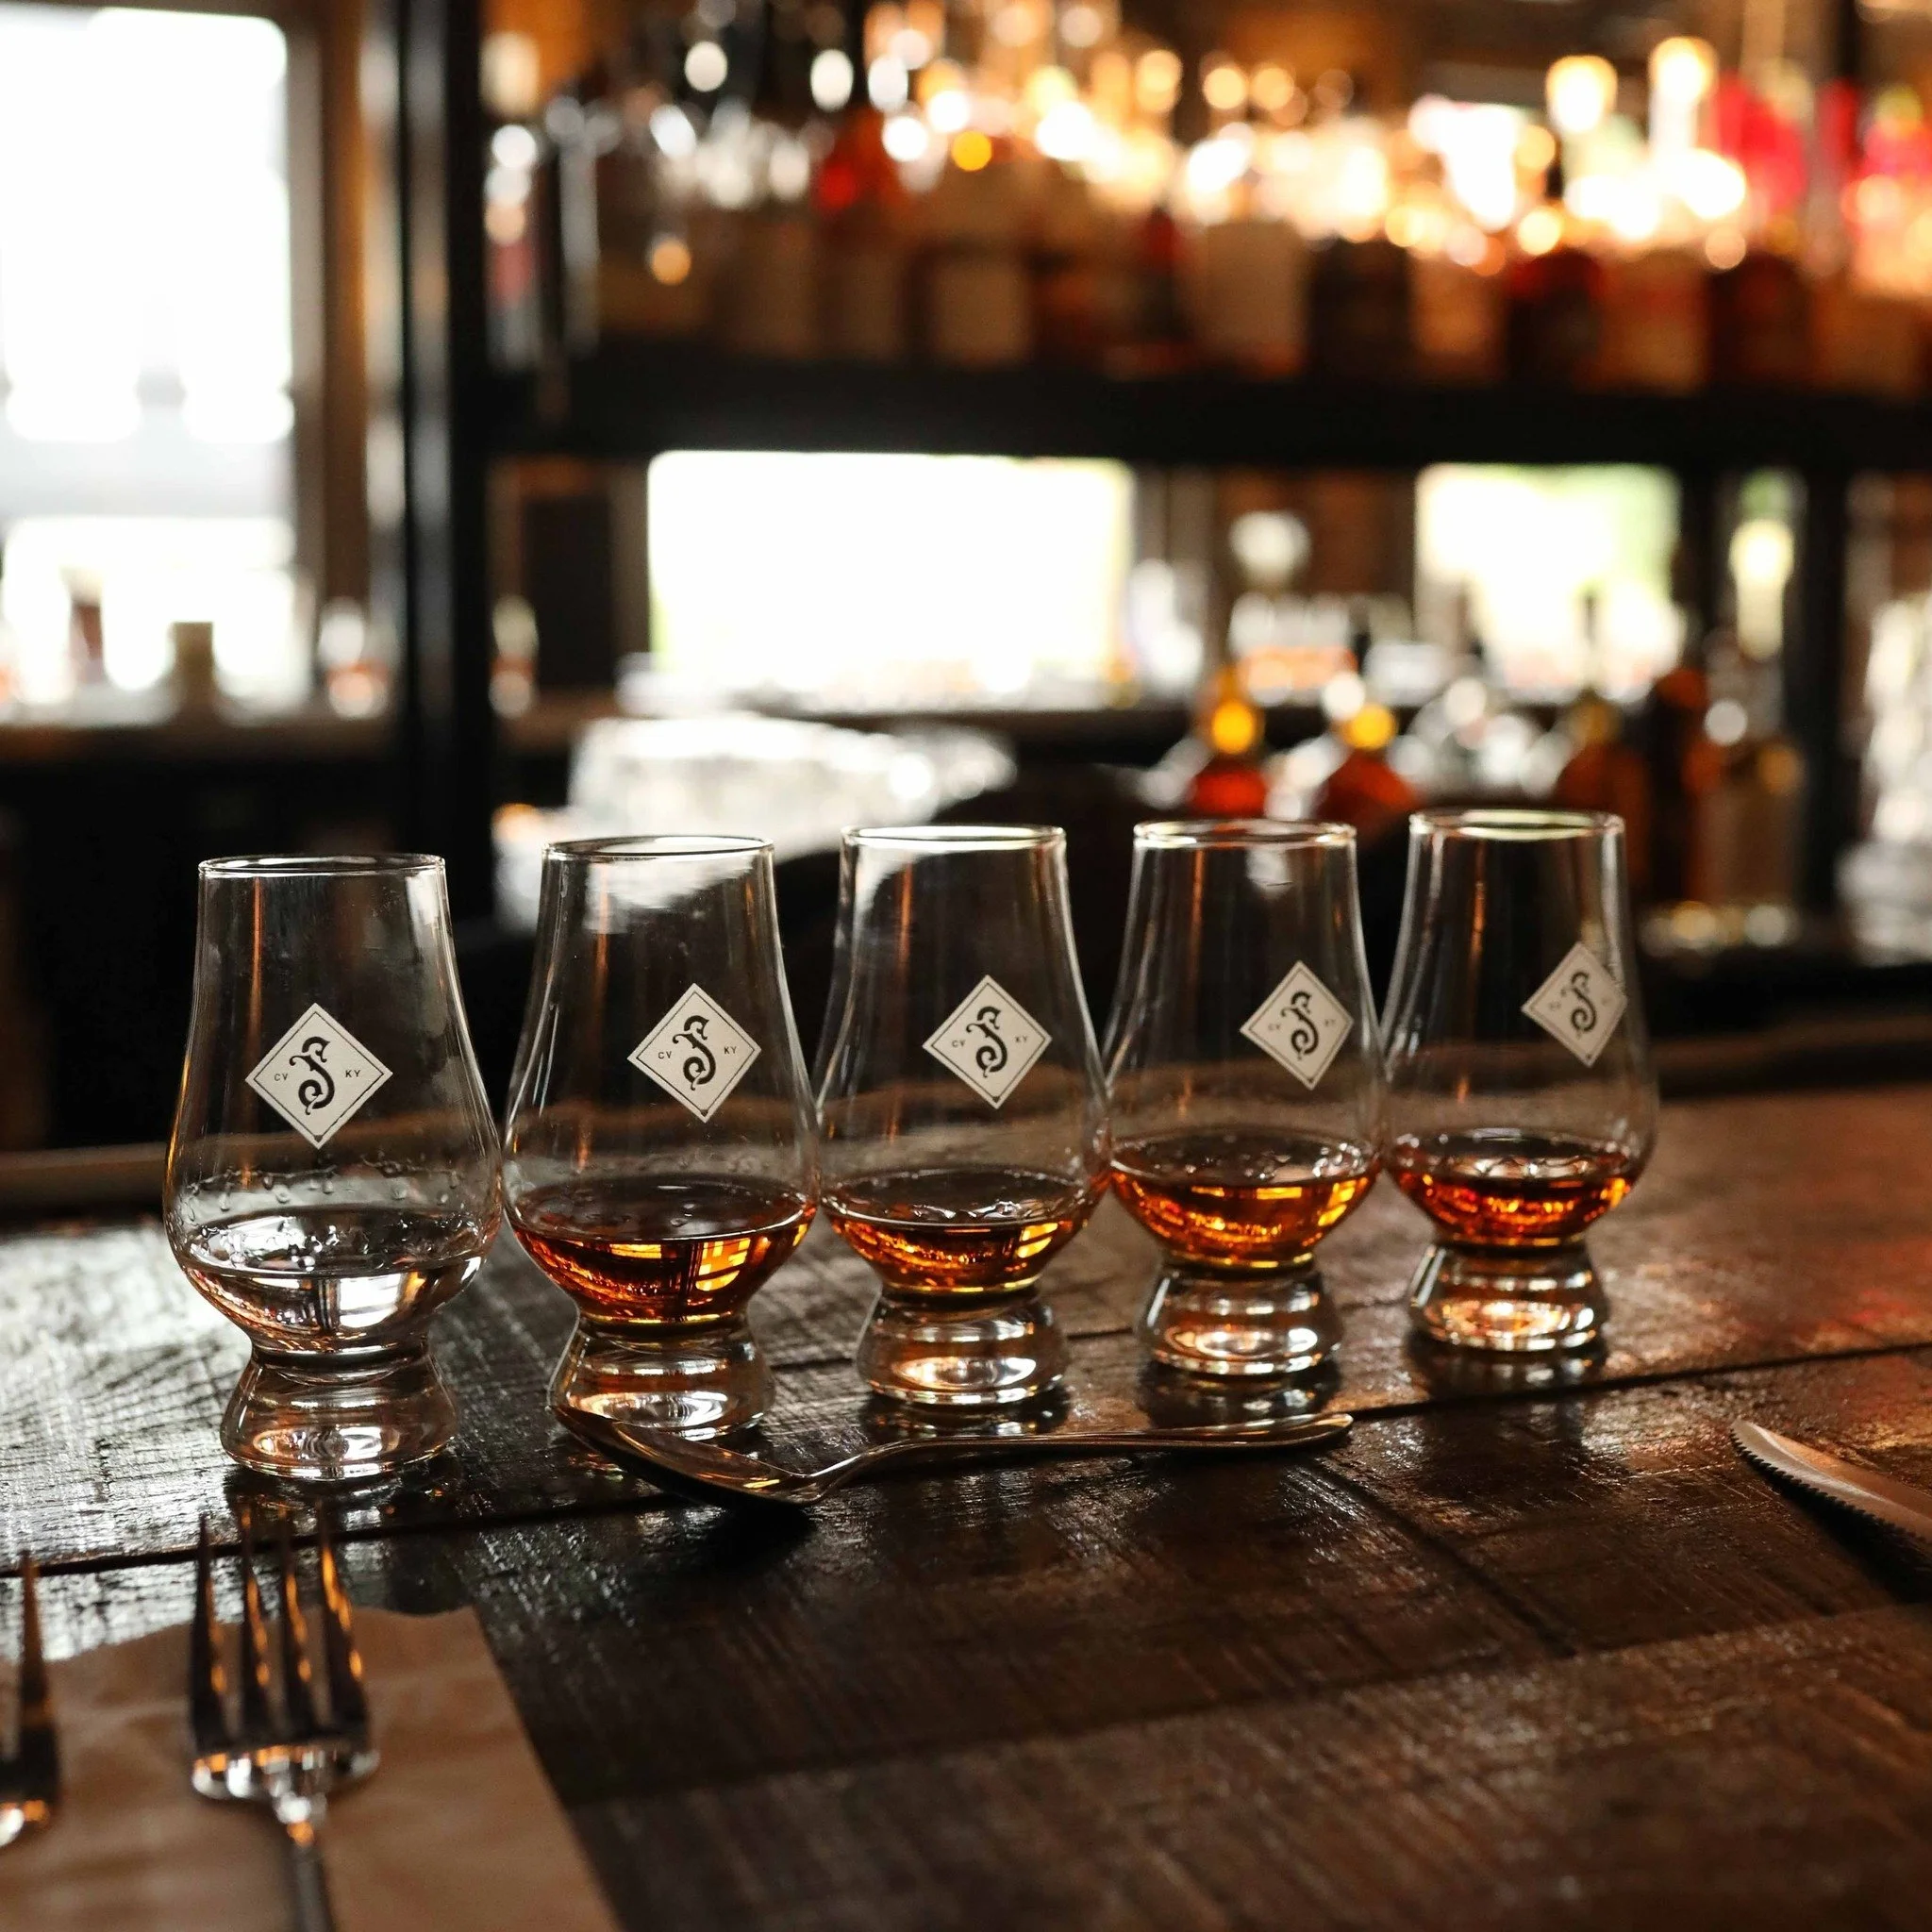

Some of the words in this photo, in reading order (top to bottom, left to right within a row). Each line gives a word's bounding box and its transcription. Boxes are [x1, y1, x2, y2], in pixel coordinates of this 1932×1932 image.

[658, 1051, 672, 1059] CV
[724, 1046, 737, 1055] KY
[274, 1073, 289, 1082] CV
[345, 1069, 361, 1078] KY
